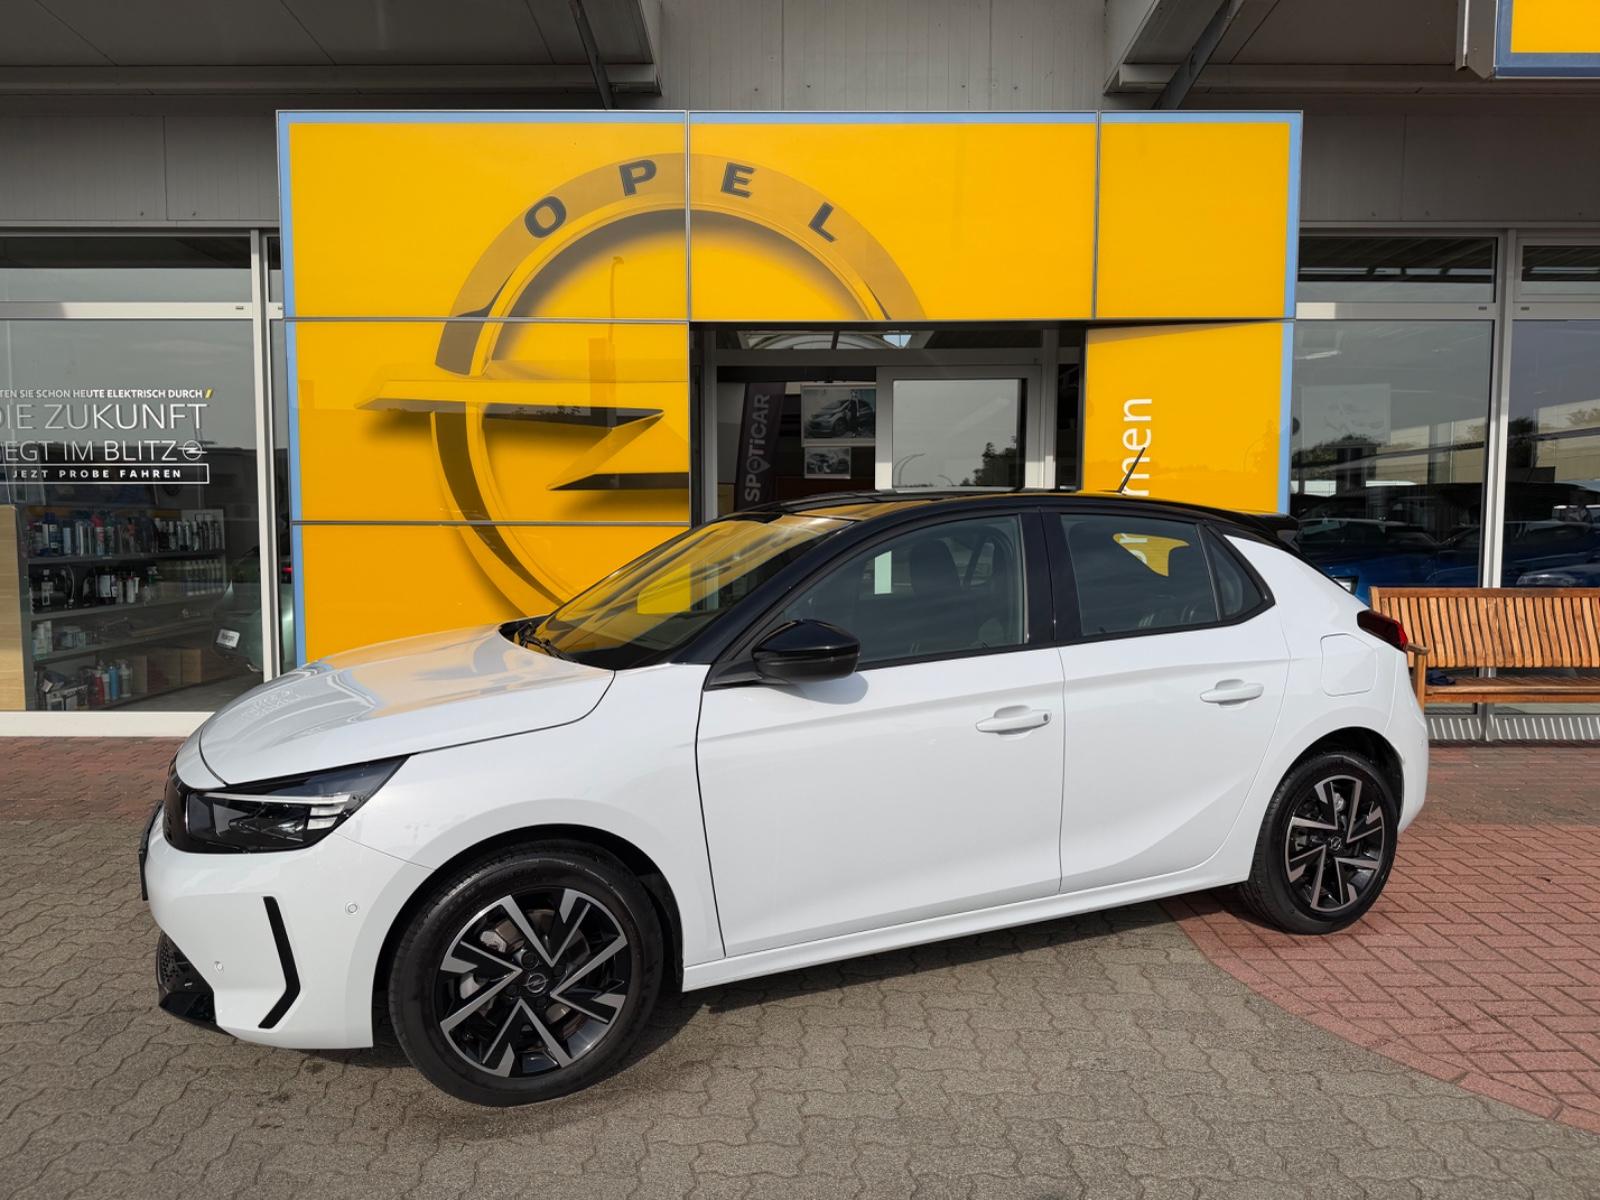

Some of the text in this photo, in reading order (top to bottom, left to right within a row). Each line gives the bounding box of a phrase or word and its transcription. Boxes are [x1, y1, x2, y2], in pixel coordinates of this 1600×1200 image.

[524, 159, 839, 243] OPEL
[0, 389, 203, 399] TEN SIE SCHON HEUTE ELEKTRISCH DURCH
[0, 403, 207, 430] IE ZUKUNFT
[64, 440, 93, 461] IM
[104, 439, 178, 461] BLITZ
[1121, 398, 1152, 496] men
[13, 469, 181, 478] JEZT PROBE FAHREN
